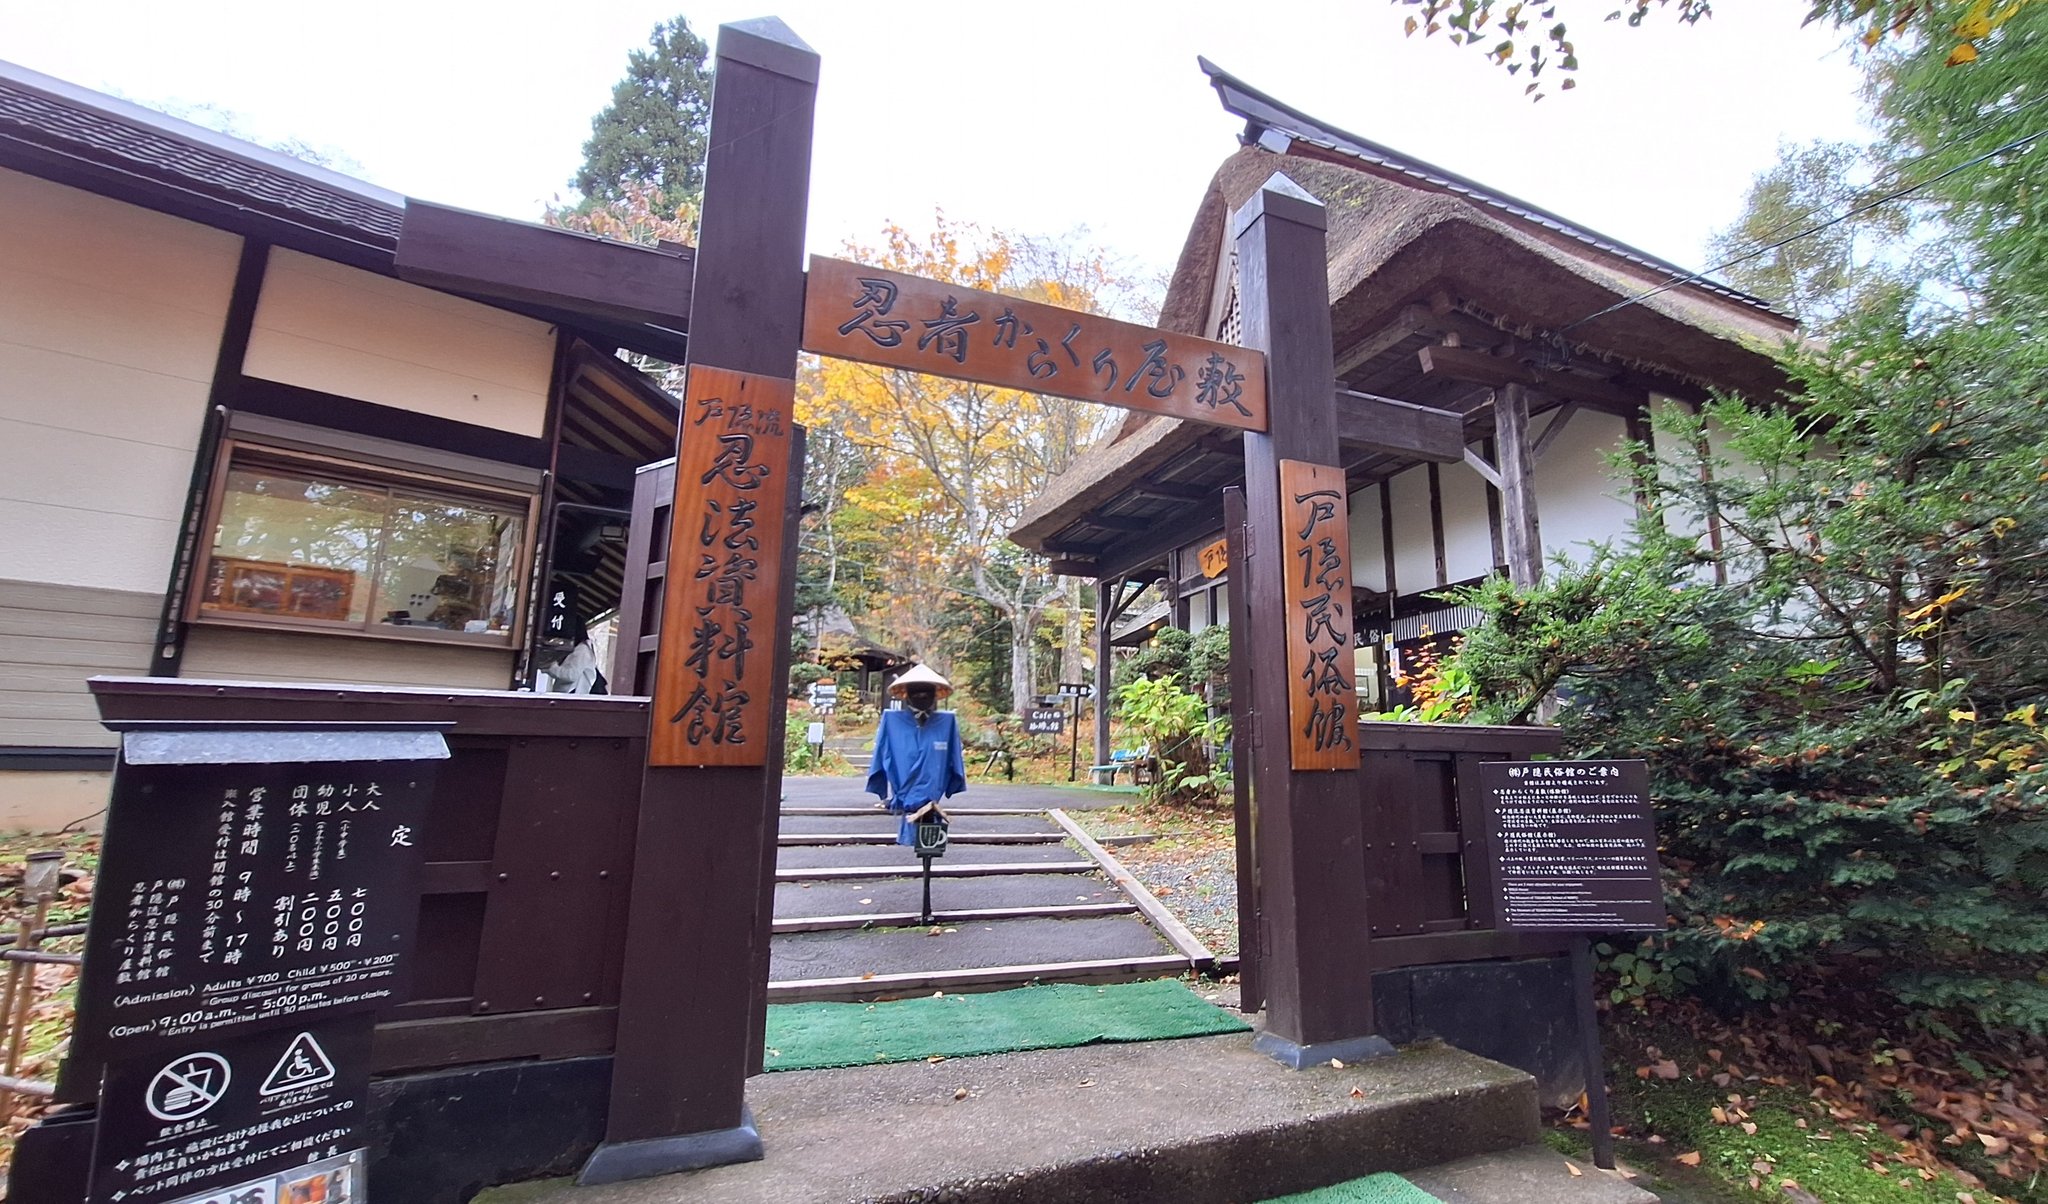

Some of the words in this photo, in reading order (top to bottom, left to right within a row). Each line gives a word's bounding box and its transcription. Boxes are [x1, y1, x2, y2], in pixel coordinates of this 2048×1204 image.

[838, 277, 1252, 417] 忍者からくり屋敷
[550, 591, 566, 631] 受付
[288, 784, 309, 818] 団体
[313, 784, 335, 816] 幼児
[336, 783, 360, 814] 小人
[361, 782, 383, 813] 大人
[240, 785, 268, 857] 営業時間
[271, 894, 296, 959] 割引あり
[202, 979, 242, 993] Adults
[287, 966, 316, 979] Child
[332, 975, 343, 985] of
[345, 973, 358, 983] 20
[210, 1013, 256, 1028] permitted
[259, 1008, 280, 1019] until
[283, 1005, 296, 1015] 30
